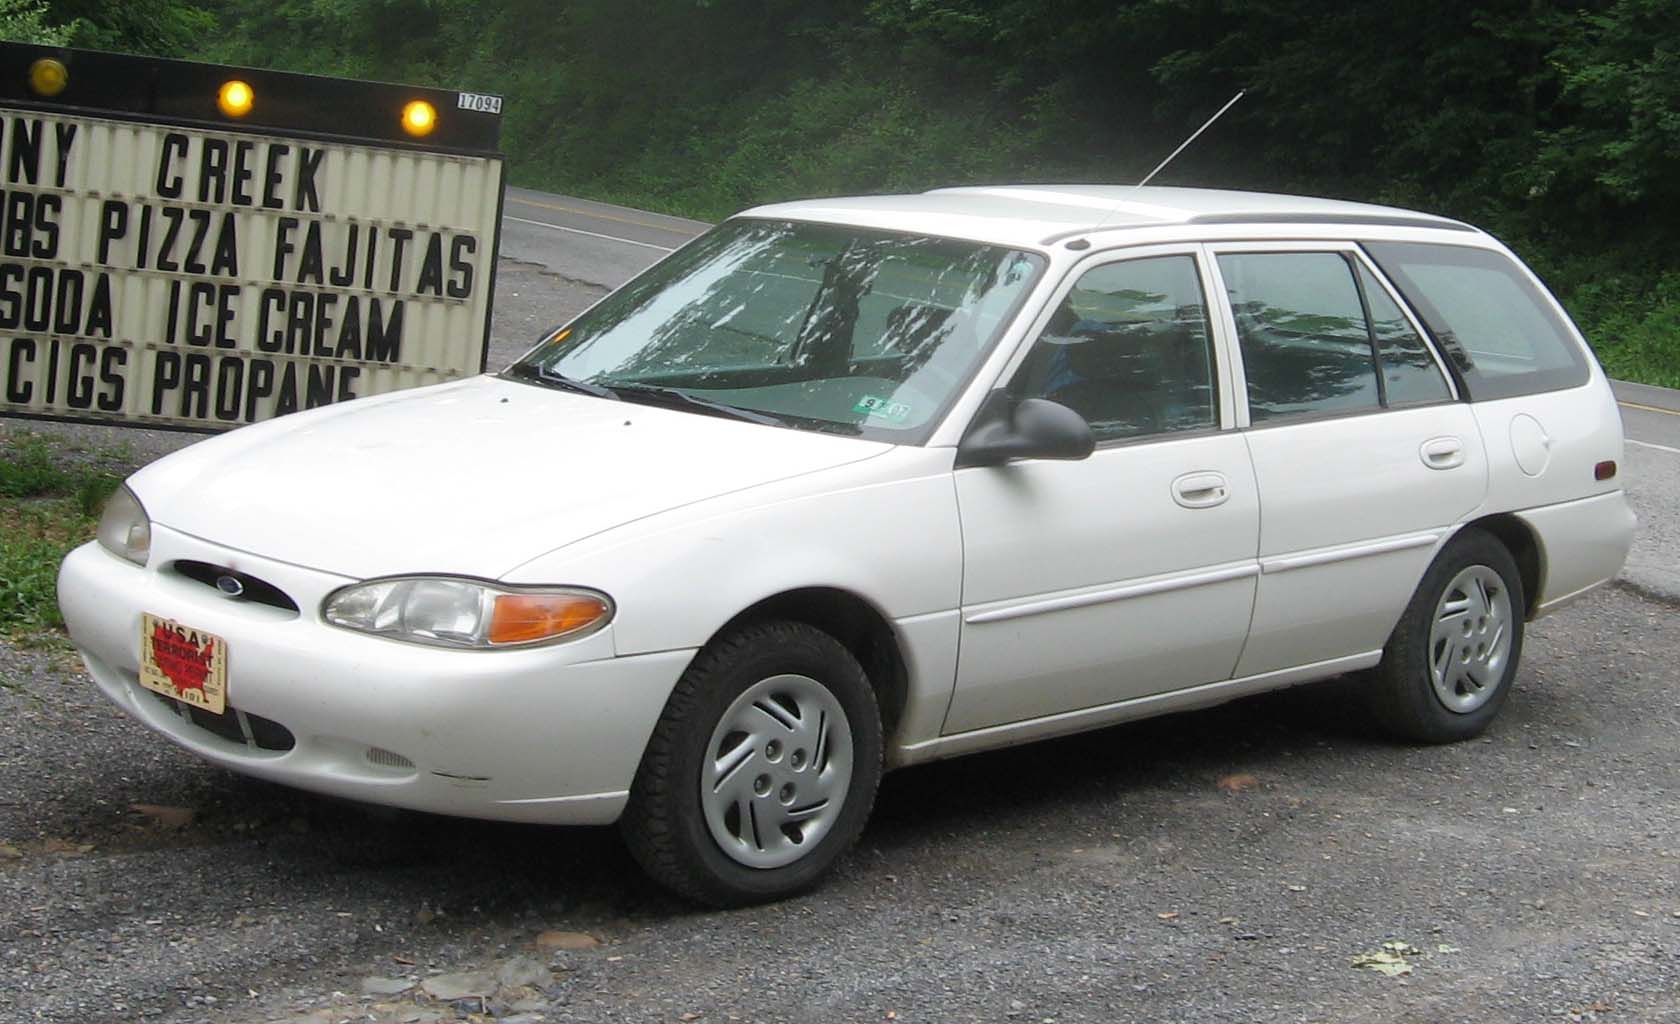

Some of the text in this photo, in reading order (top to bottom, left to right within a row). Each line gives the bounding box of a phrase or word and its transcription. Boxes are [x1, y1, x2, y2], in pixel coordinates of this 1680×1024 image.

[460, 94, 499, 112] 17094
[0, 117, 323, 212] NY CREEK
[0, 189, 476, 299] BS PIZZA FAJITAS
[0, 263, 404, 362] SODA ICE CREAM
[7, 338, 127, 411] CIGS
